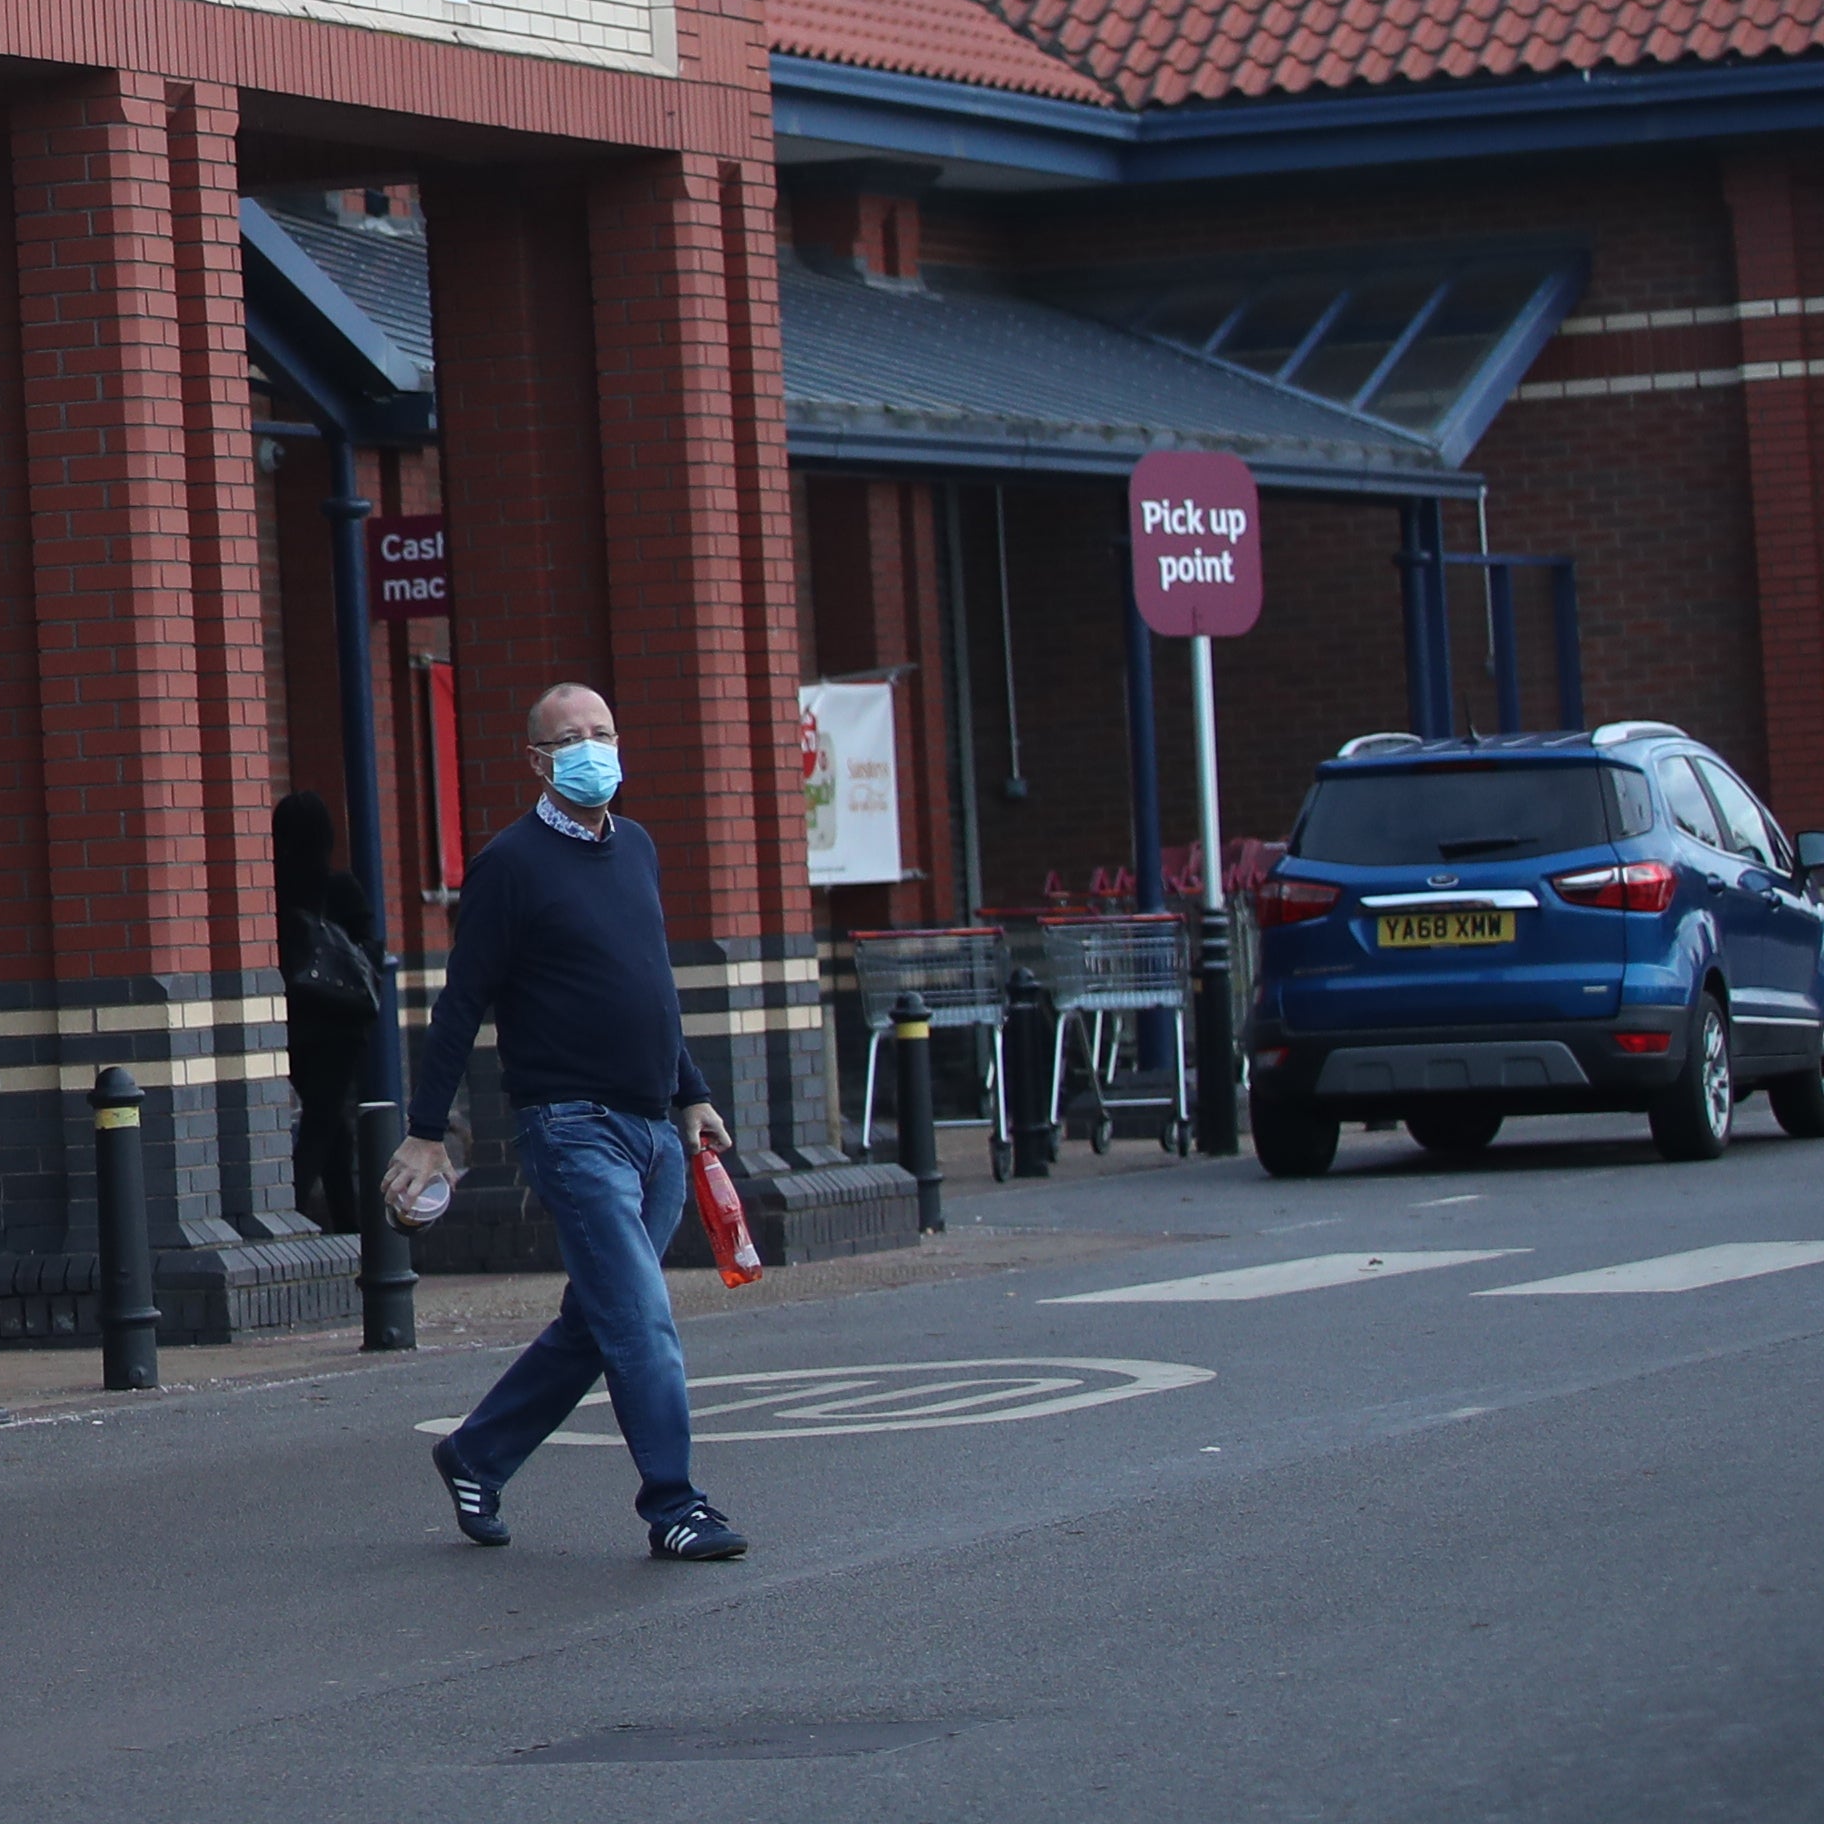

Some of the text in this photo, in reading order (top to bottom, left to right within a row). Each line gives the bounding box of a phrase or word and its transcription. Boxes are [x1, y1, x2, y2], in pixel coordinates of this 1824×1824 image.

[1141, 499, 1247, 544] Pick up
[1158, 547, 1235, 592] point
[1386, 914, 1502, 941] YA68 XMW
